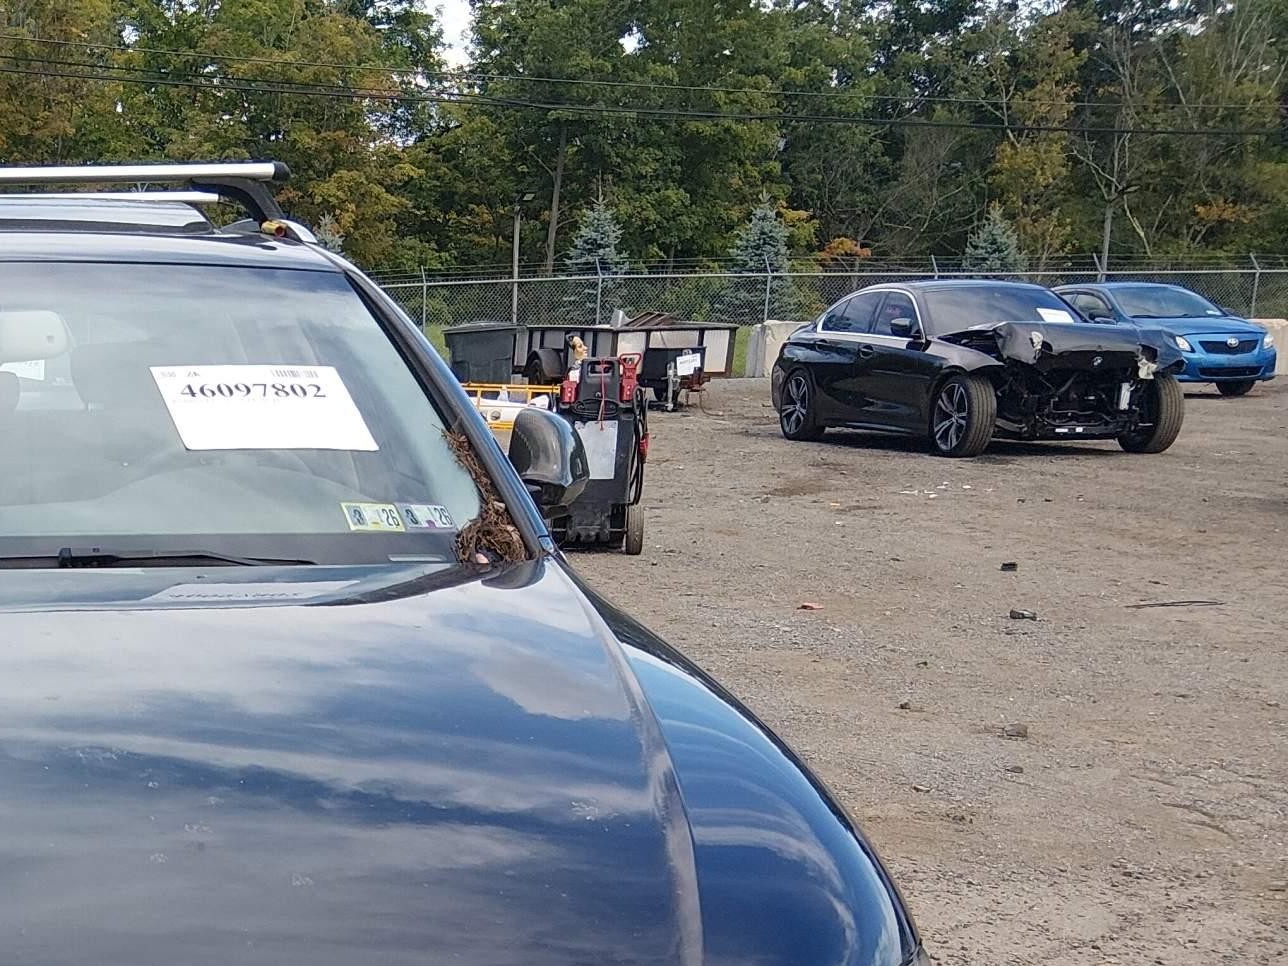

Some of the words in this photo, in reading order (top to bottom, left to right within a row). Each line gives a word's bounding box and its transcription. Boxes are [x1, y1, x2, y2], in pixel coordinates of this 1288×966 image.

[180, 383, 326, 398] 46097802
[382, 508, 400, 527] 26
[405, 508, 419, 525] 3
[434, 507, 453, 526] 26
